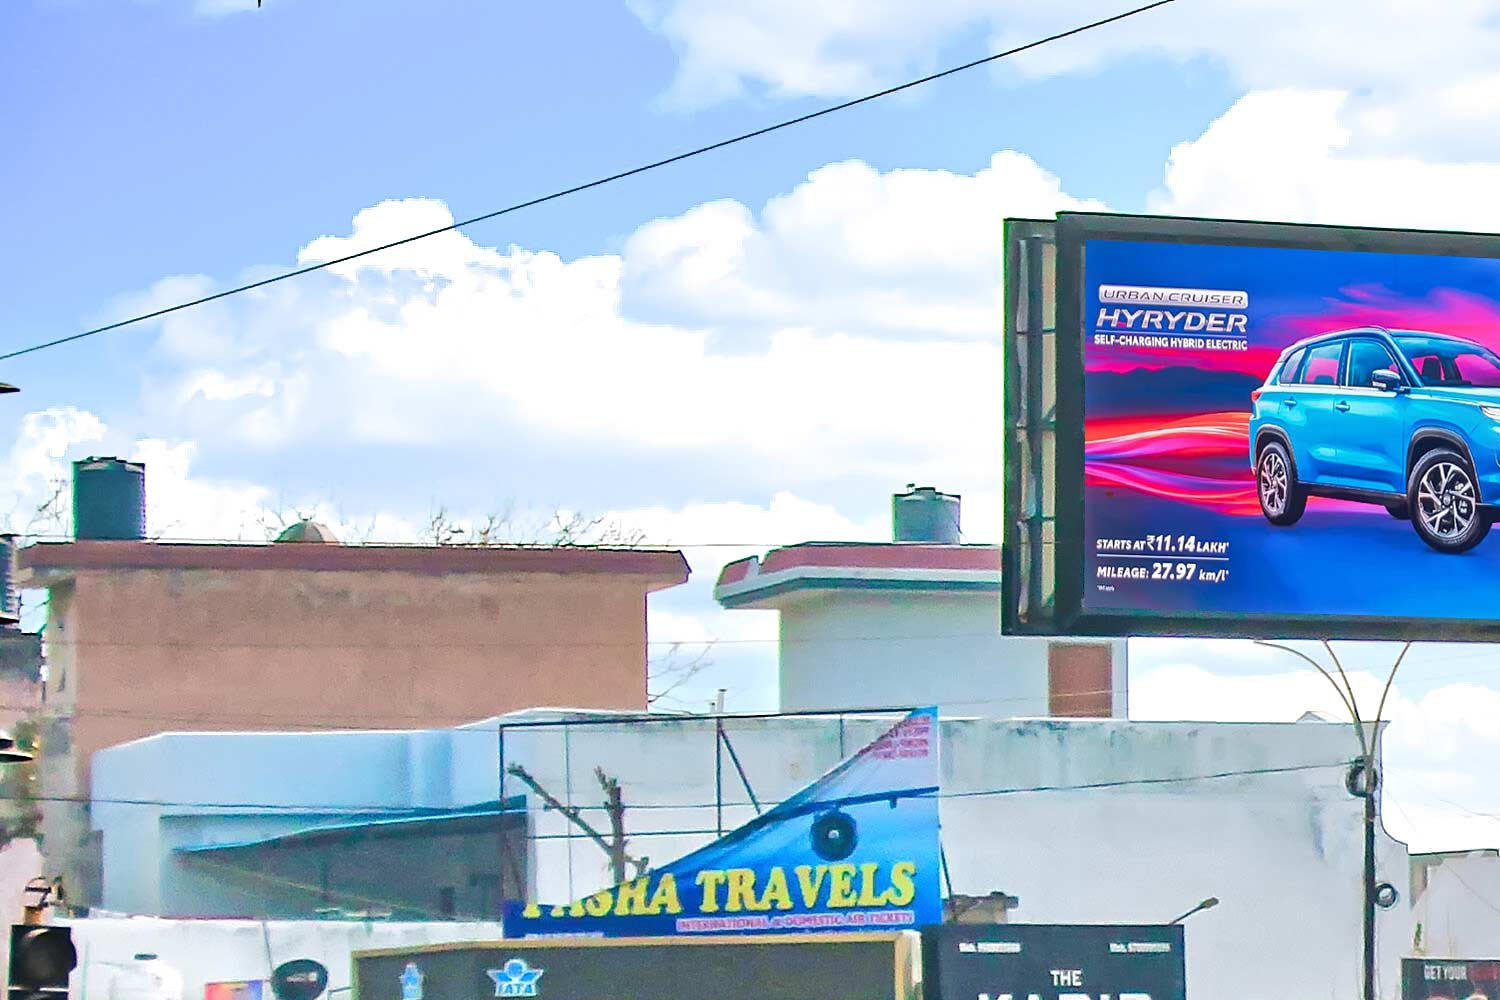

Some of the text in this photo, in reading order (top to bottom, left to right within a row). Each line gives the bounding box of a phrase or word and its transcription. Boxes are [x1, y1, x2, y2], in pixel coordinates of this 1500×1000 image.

[1103, 289, 1244, 305] URBAN CRUISER
[1096, 308, 1248, 333] HYRYDER
[1094, 334, 1248, 351] SELF-CHARGING HYBRID ELECTRIC
[1096, 538, 1132, 550] STARTS
[1133, 540, 1146, 550] AT
[1096, 566, 1150, 579] MILEAGE:
[1151, 562, 1197, 580] 27.97
[695, 863, 917, 913] TRAVELS
[1050, 969, 1082, 987] THE
